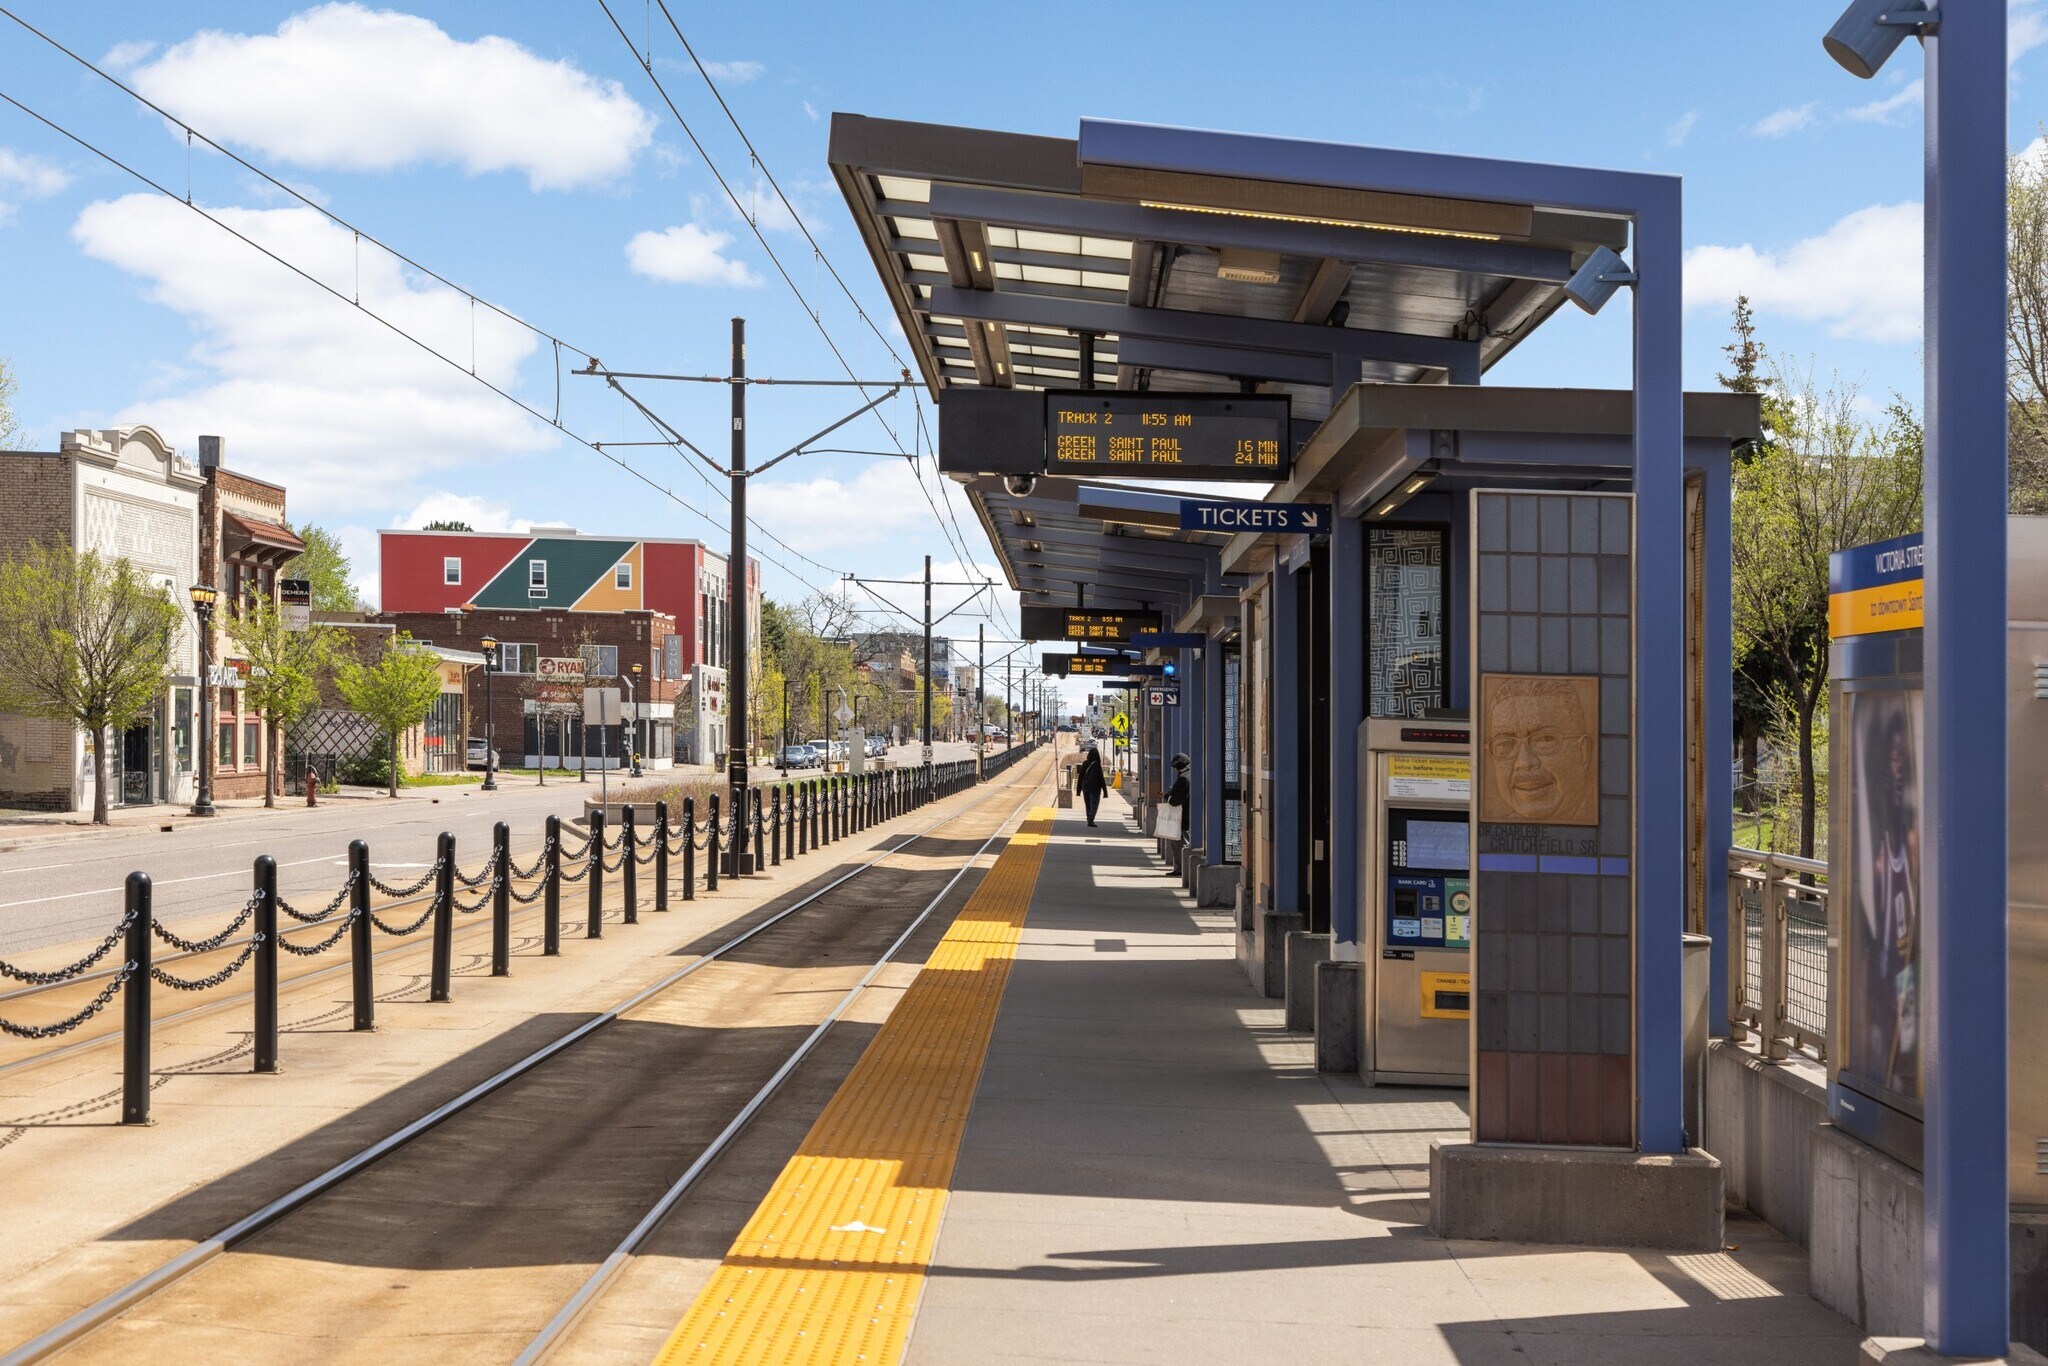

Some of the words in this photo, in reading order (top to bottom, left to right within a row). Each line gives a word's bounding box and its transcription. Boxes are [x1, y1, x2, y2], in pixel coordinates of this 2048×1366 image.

[1058, 411, 1097, 424] TRACK
[1104, 413, 1112, 424] 2
[1142, 413, 1167, 426] 11:55
[1174, 414, 1192, 426] AM
[1057, 435, 1096, 448] GREEN
[1109, 436, 1144, 449] SAINT
[1151, 438, 1182, 450] PAUL
[1238, 440, 1254, 452] 16
[1258, 441, 1278, 453] MIN
[1057, 448, 1096, 460] GREEN
[1109, 449, 1144, 462] SAINT
[1151, 450, 1182, 463] PAUL
[1235, 452, 1254, 464] 24
[1258, 453, 1278, 465] MIN
[1198, 507, 1288, 527] TICKETS
[1875, 548, 1906, 574] VICTORIA
[1906, 544, 1925, 568] STREE
[1870, 603, 1877, 617] to
[1878, 596, 1907, 616] downtown
[1908, 591, 1923, 611] Saint
[557, 661, 585, 673] RYAN
[923, 749, 933, 757] 35
[1496, 825, 1538, 838] CHARLES
